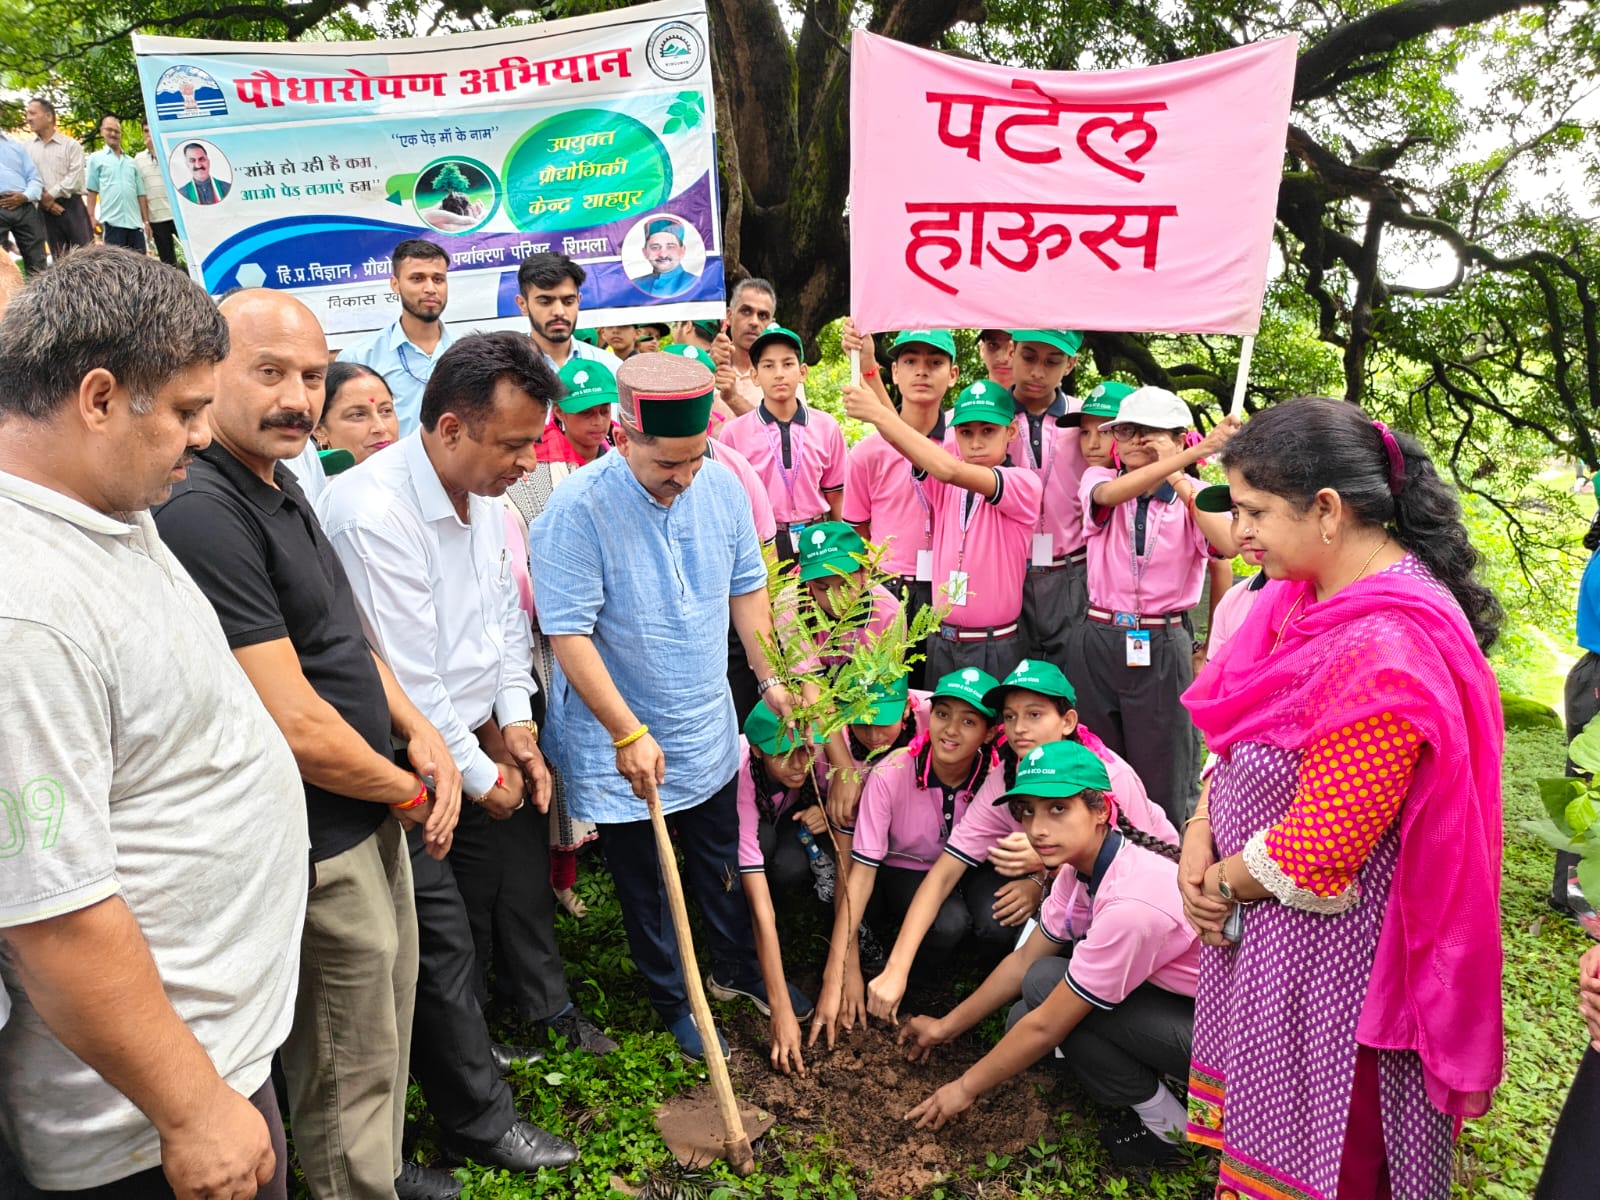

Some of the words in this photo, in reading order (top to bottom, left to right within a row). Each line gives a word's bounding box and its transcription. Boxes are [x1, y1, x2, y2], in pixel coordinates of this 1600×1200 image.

[232, 68, 448, 108] पौधारोपण
[459, 47, 633, 95] अभियान
[420, 128, 437, 148] पेड़
[455, 126, 468, 142] के
[546, 130, 617, 155] उपयुक्त
[925, 78, 1168, 183] पटेल
[279, 158, 297, 175] हो
[301, 155, 325, 173] रही
[328, 154, 341, 171] है
[240, 183, 276, 201] आओ
[304, 178, 345, 196] लगाएं
[528, 195, 575, 216] केन्द्र
[582, 189, 646, 212] शाहपुर
[452, 245, 505, 266] पर्यावरण
[562, 236, 608, 255] शिमला
[904, 202, 1179, 297] हाऊस
[327, 294, 376, 309] विकास
